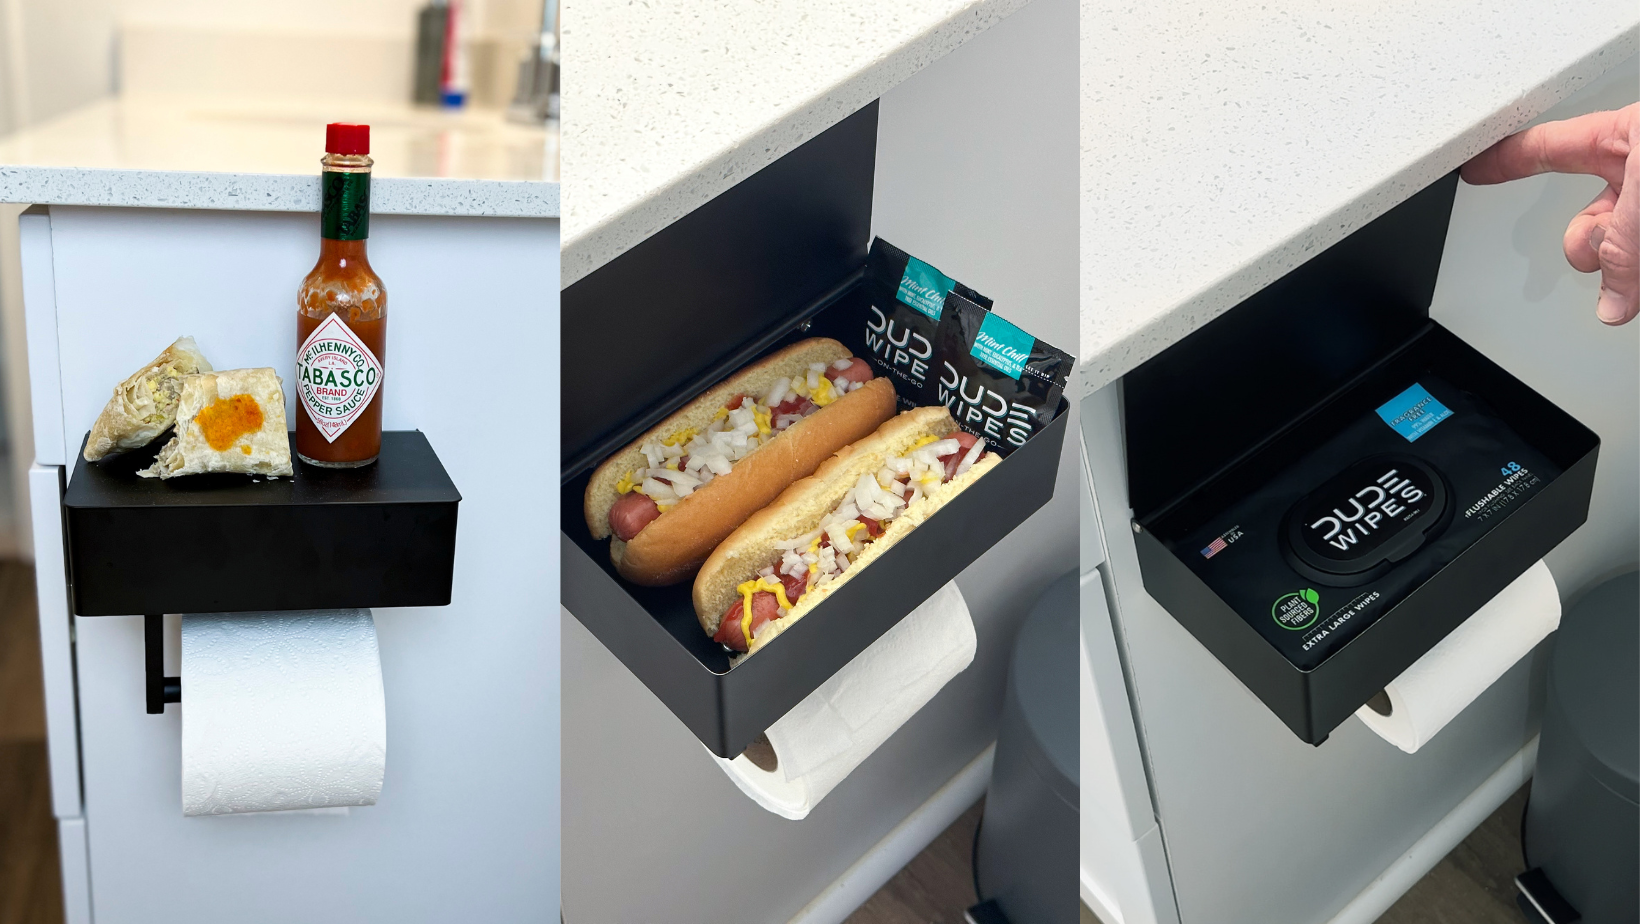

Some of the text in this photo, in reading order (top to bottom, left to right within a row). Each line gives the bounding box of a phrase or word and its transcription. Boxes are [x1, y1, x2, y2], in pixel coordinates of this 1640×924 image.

[901, 276, 928, 294] Mint
[867, 305, 932, 360] DUD
[866, 328, 929, 380] WIPE
[976, 332, 1029, 363] Mint Chill
[297, 362, 376, 387] TABASCO
[303, 384, 365, 415] PEPPER SAUCE
[316, 387, 347, 396] BRAND
[940, 360, 1037, 431] DUDE
[939, 383, 1028, 446] WIPES
[1390, 396, 1432, 426] FRAGRANCE
[1408, 409, 1425, 422] FREE
[1501, 461, 1521, 476] 48
[1504, 468, 1528, 485] WIPES
[1310, 469, 1411, 540] DUDE
[1329, 486, 1424, 551] WIPES
[1228, 531, 1244, 543] USA
[1279, 601, 1308, 623] SOURCED
[1280, 596, 1302, 612] PLANT
[1290, 607, 1314, 625] FIBERS
[1302, 591, 1380, 651] EXTRA LARGE WIPES
